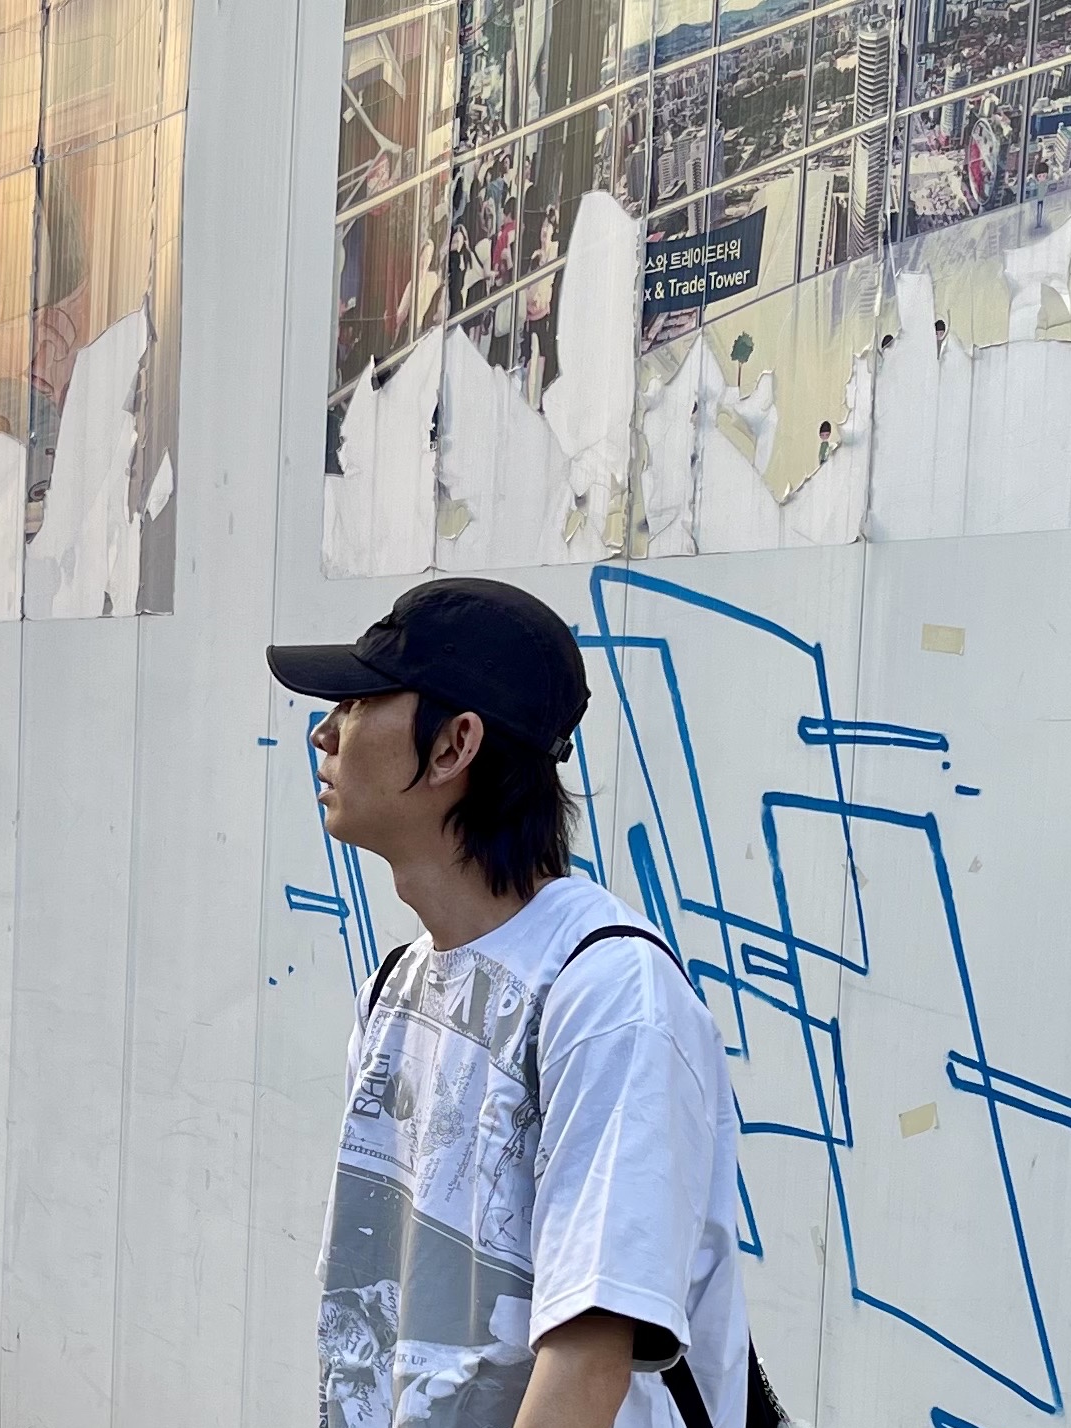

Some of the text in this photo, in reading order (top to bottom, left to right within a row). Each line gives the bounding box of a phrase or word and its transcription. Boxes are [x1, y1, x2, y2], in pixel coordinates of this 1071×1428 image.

[654, 281, 664, 299] &
[669, 275, 706, 297] Trade
[709, 269, 750, 290] Tower
